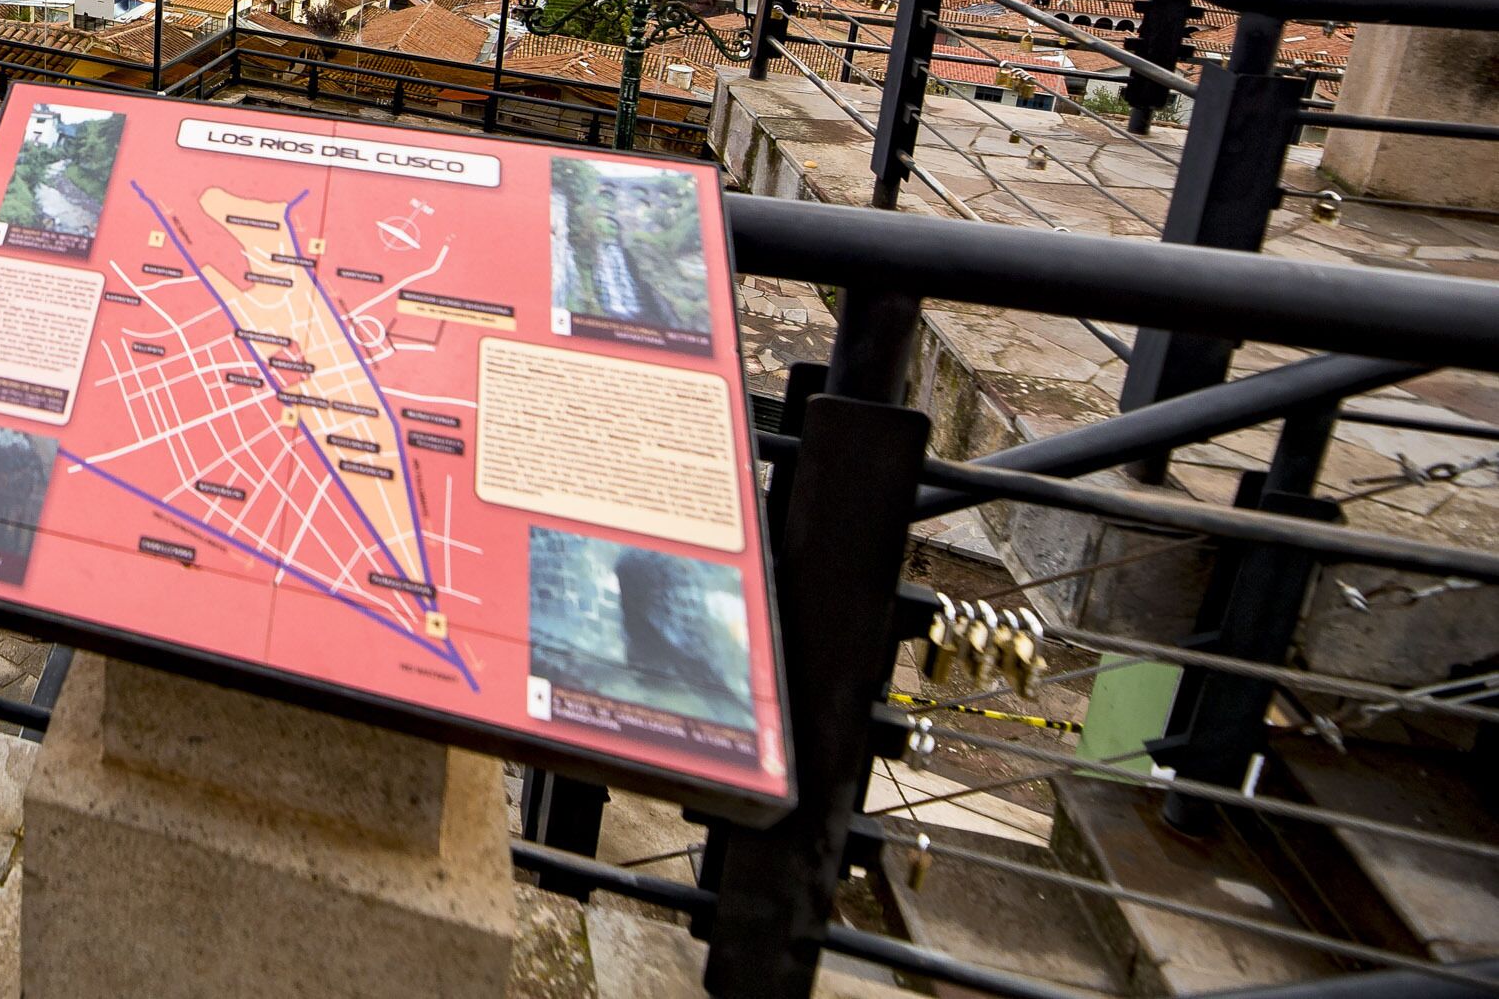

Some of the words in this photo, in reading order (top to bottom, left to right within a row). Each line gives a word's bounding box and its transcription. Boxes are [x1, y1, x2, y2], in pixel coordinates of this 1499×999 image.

[207, 131, 254, 147] LOS
[321, 145, 369, 162] DEL
[376, 152, 465, 174] CUSCO
